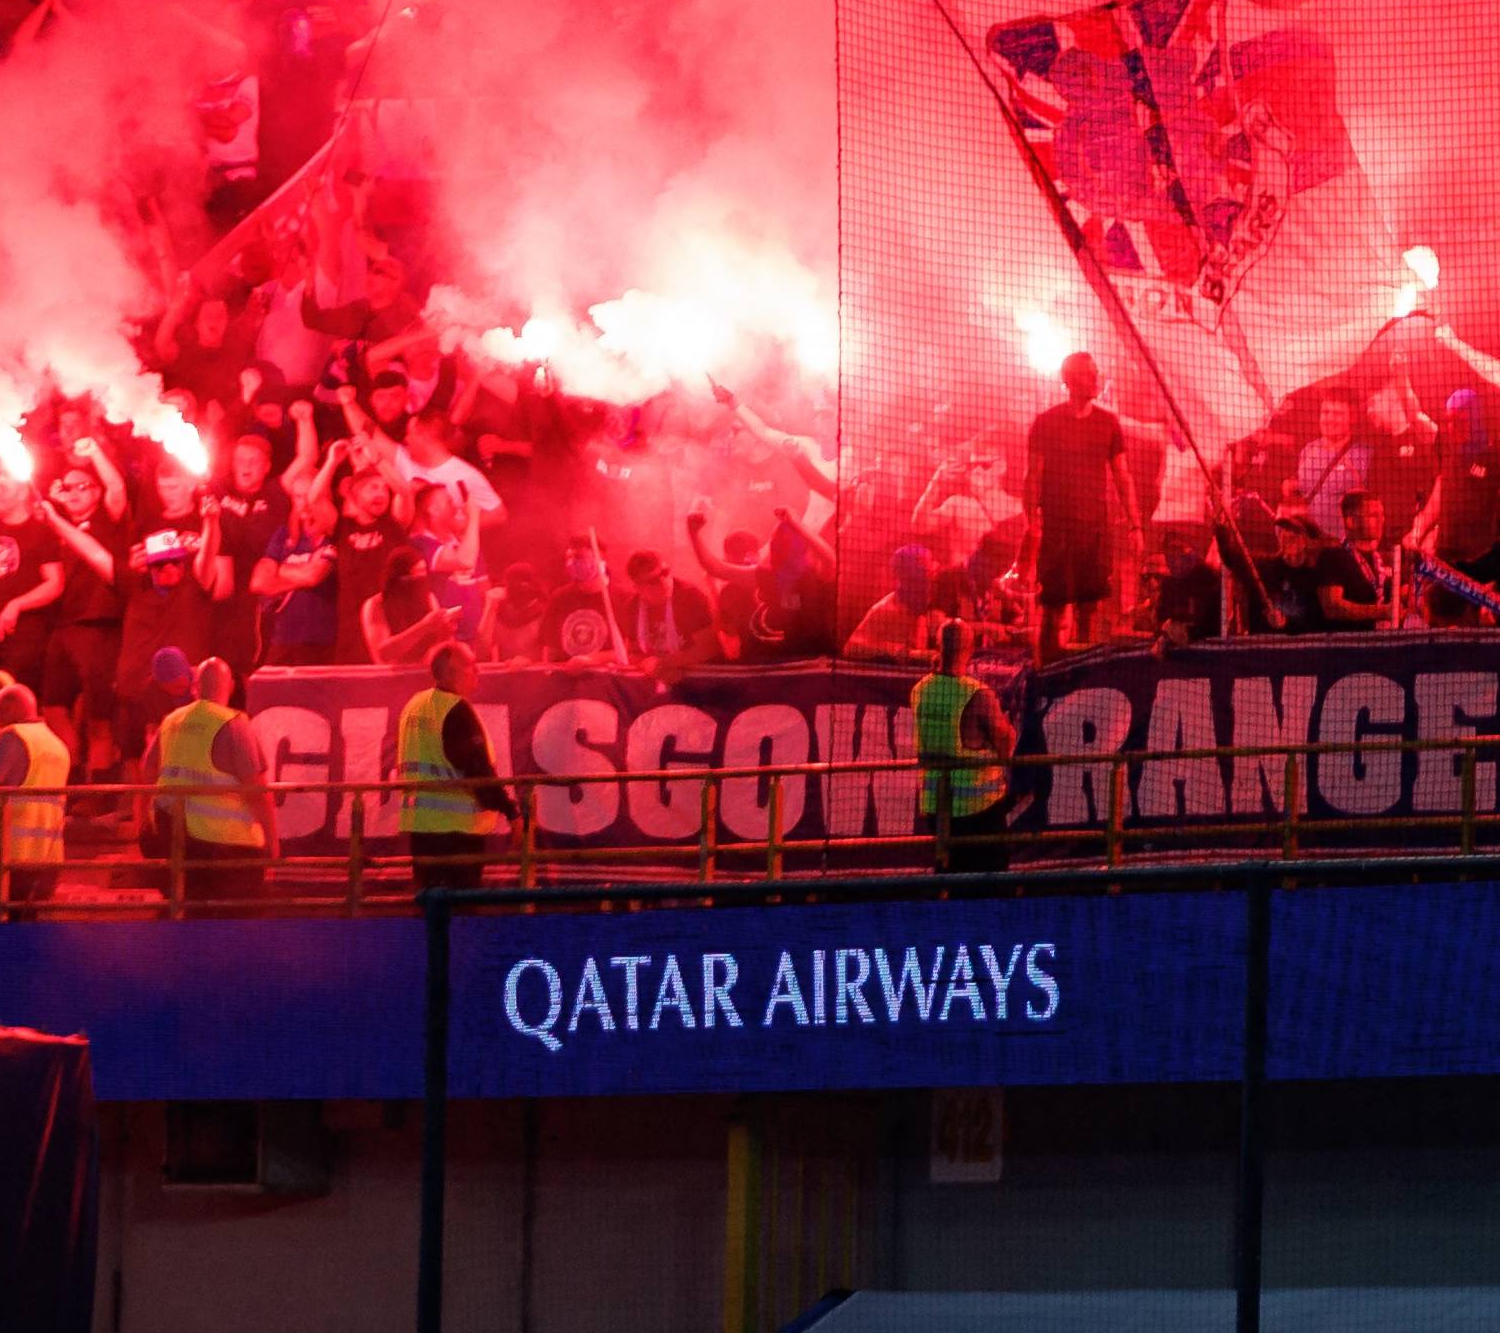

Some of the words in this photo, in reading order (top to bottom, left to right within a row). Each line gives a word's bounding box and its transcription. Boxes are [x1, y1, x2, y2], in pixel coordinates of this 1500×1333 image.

[262, 699, 918, 841] GLSGOW
[503, 952, 745, 1051] QATAR
[762, 943, 1061, 1025] AIRWAYS
